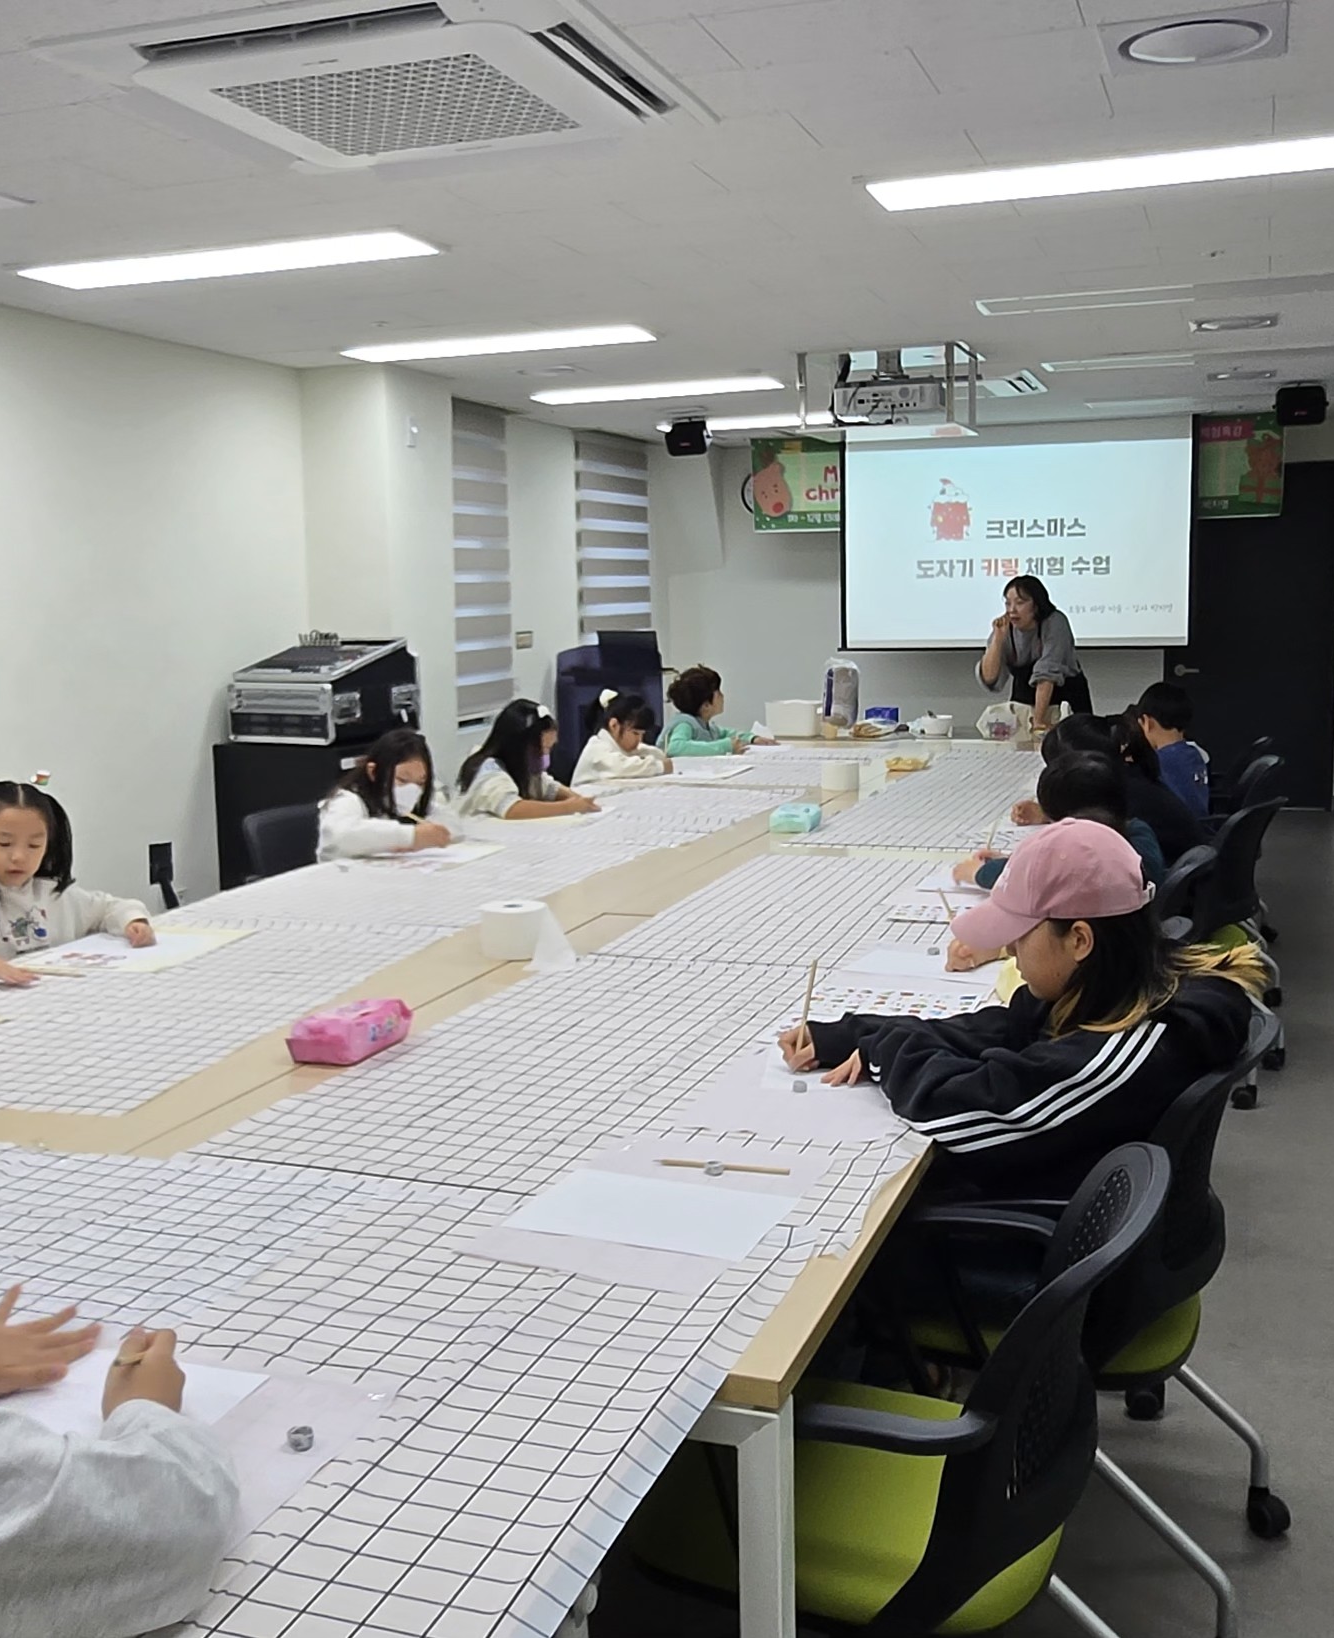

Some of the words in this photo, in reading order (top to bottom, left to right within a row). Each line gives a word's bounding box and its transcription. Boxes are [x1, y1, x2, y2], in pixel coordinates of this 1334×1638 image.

[986, 517, 1086, 539] 크리스마스
[916, 558, 974, 579] 도자기
[981, 558, 1019, 576] 키링
[1025, 556, 1064, 576] 체험
[1071, 555, 1111, 576] 수업
